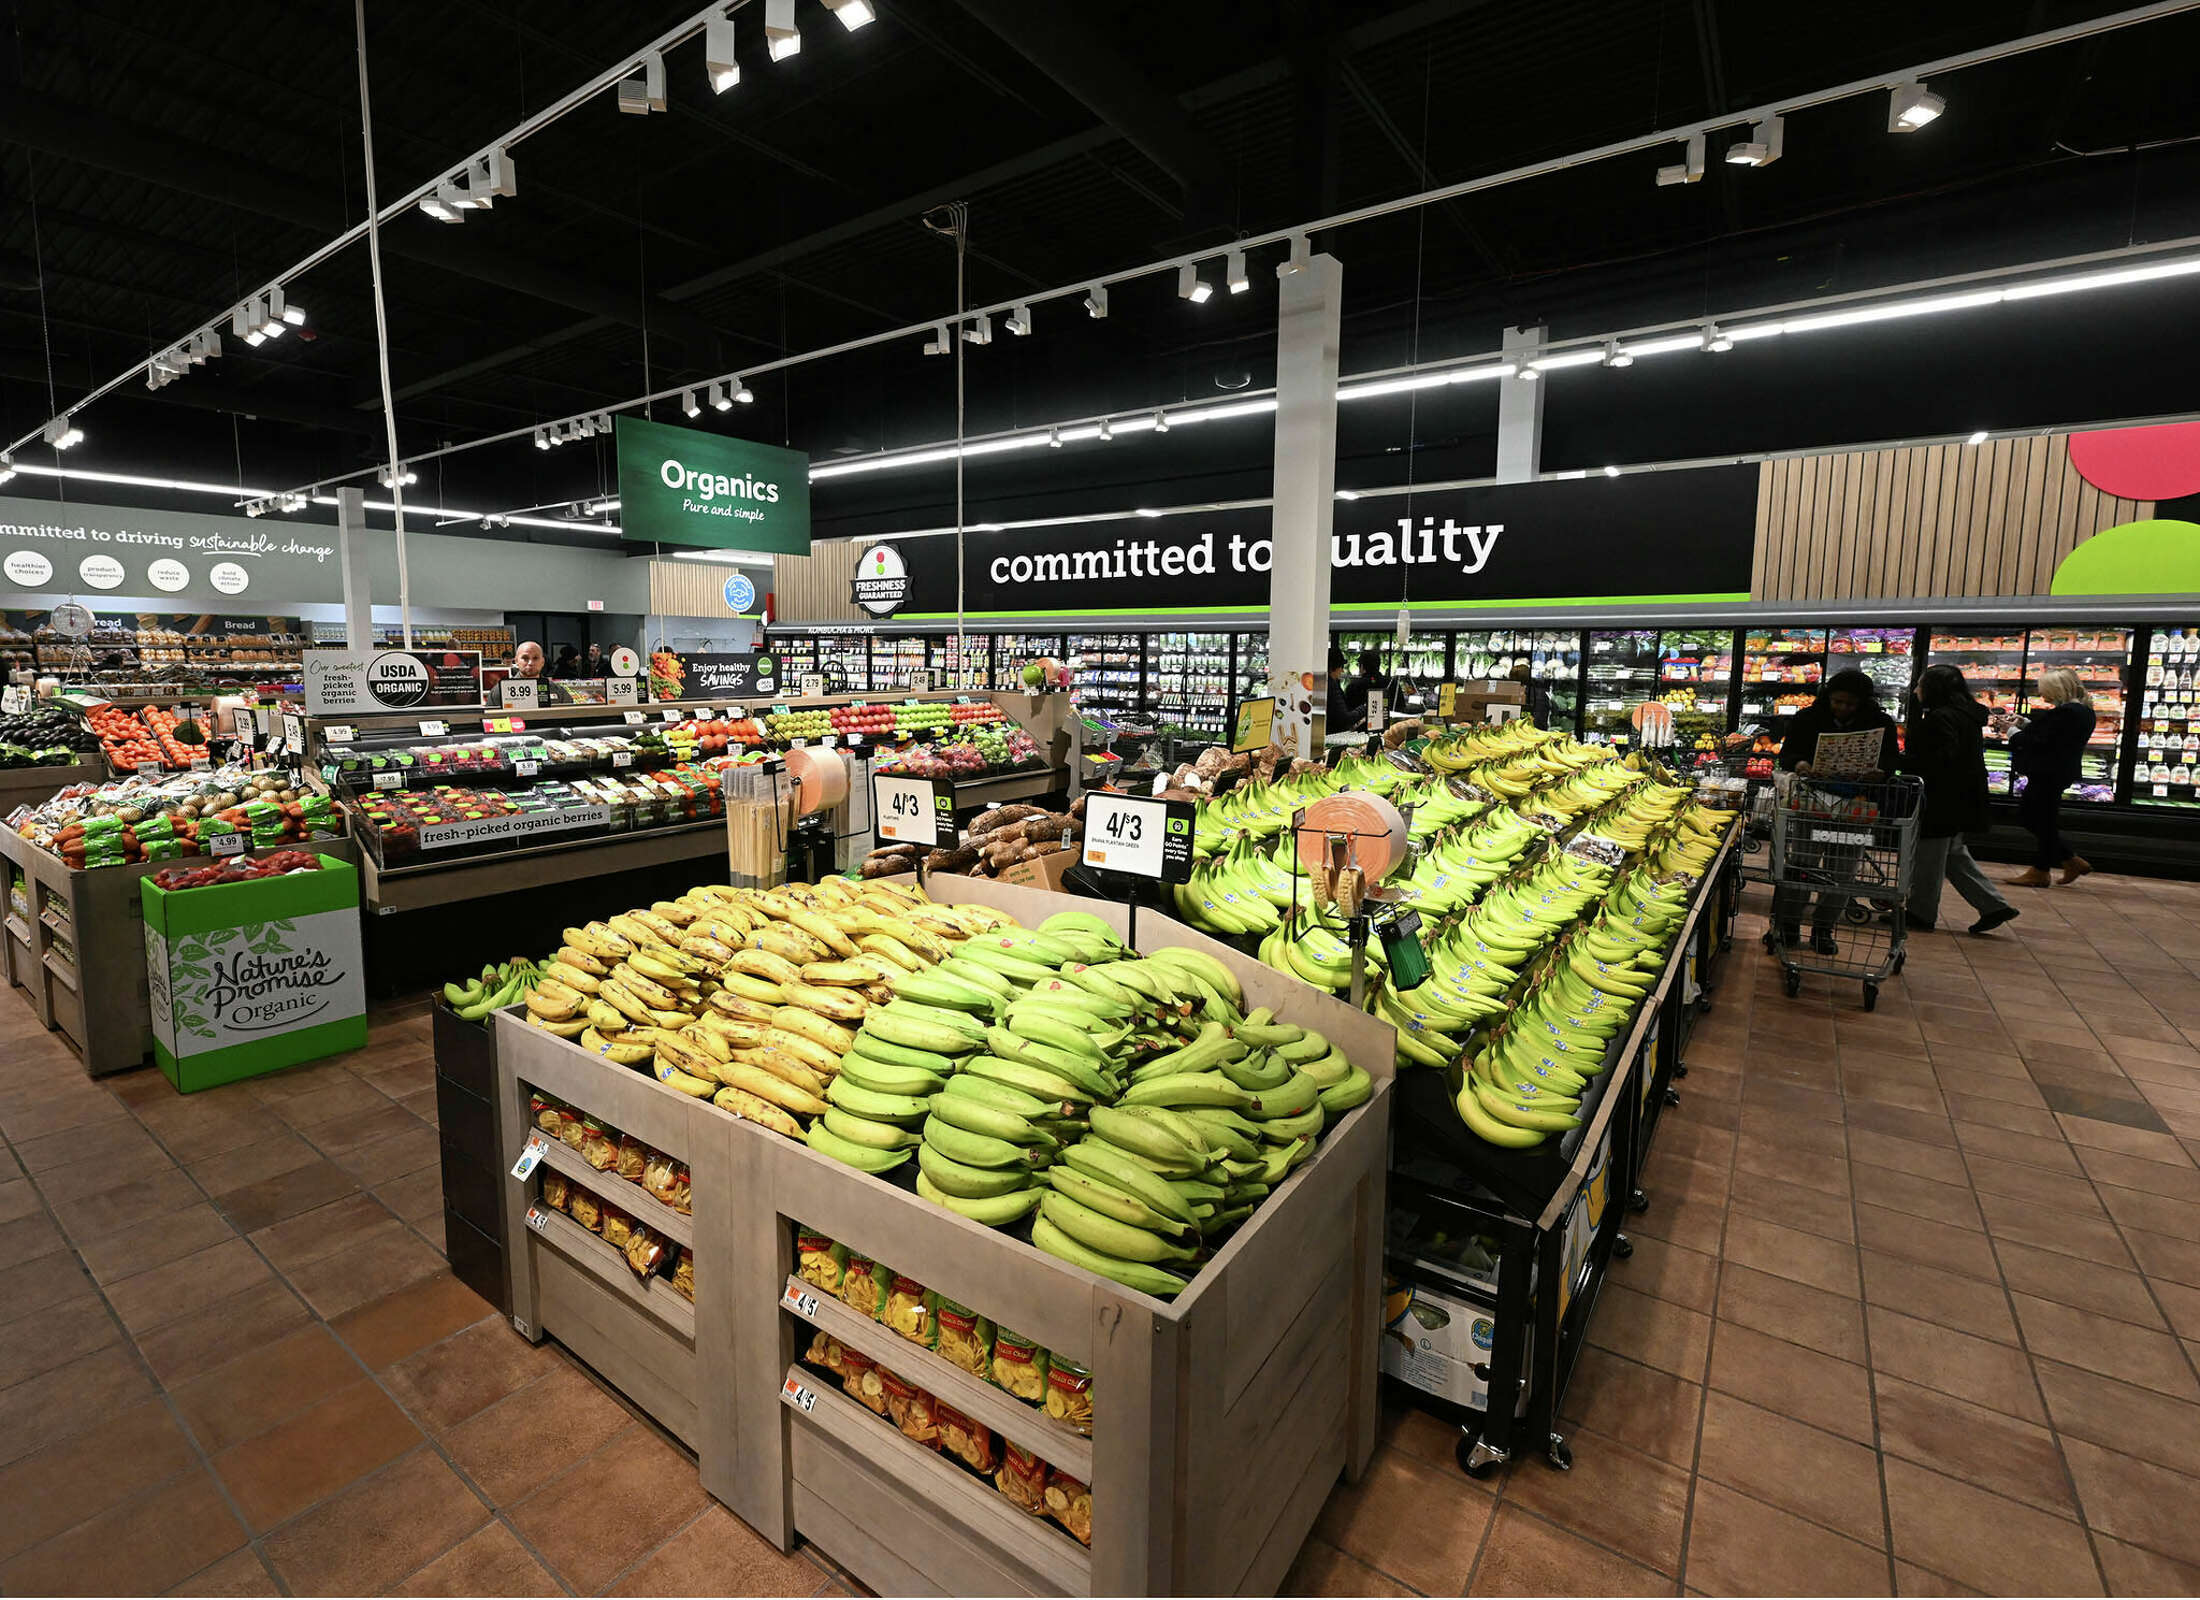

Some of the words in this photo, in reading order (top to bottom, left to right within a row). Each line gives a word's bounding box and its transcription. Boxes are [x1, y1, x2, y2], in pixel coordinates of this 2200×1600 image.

[661, 459, 778, 502] Organics
[683, 498, 709, 513] Pure
[710, 504, 732, 518] and
[734, 508, 765, 524] simple
[90, 529, 111, 542] to
[116, 530, 184, 549] driving
[189, 532, 278, 552] sustainable
[281, 538, 334, 563] change
[990, 533, 1216, 584] committed
[1228, 534, 1272, 573] to
[1330, 516, 1505, 574] uality
[10, 562, 46, 570] healthier
[856, 580, 906, 592] FRESHNESS
[858, 591, 903, 600] GUARANTEED
[95, 618, 122, 627] read
[224, 620, 256, 630] Bread
[309, 660, 328, 675] Our
[380, 664, 417, 678] USDA
[692, 664, 718, 674] Enjoy
[720, 662, 750, 673] healthy
[324, 674, 352, 682] fresh-
[700, 673, 744, 686] SAVINGS
[323, 682, 354, 690] picked
[376, 682, 422, 694] ORGANIC
[320, 690, 357, 698] organic
[322, 696, 356, 704] berries
[424, 822, 510, 843] fresh-picked
[513, 816, 561, 833] organic
[562, 810, 603, 824] berries
[1106, 812, 1142, 840] 4/$3
[214, 948, 332, 988] Nature's
[204, 971, 346, 1020] Promise
[232, 992, 317, 1024] Organic
